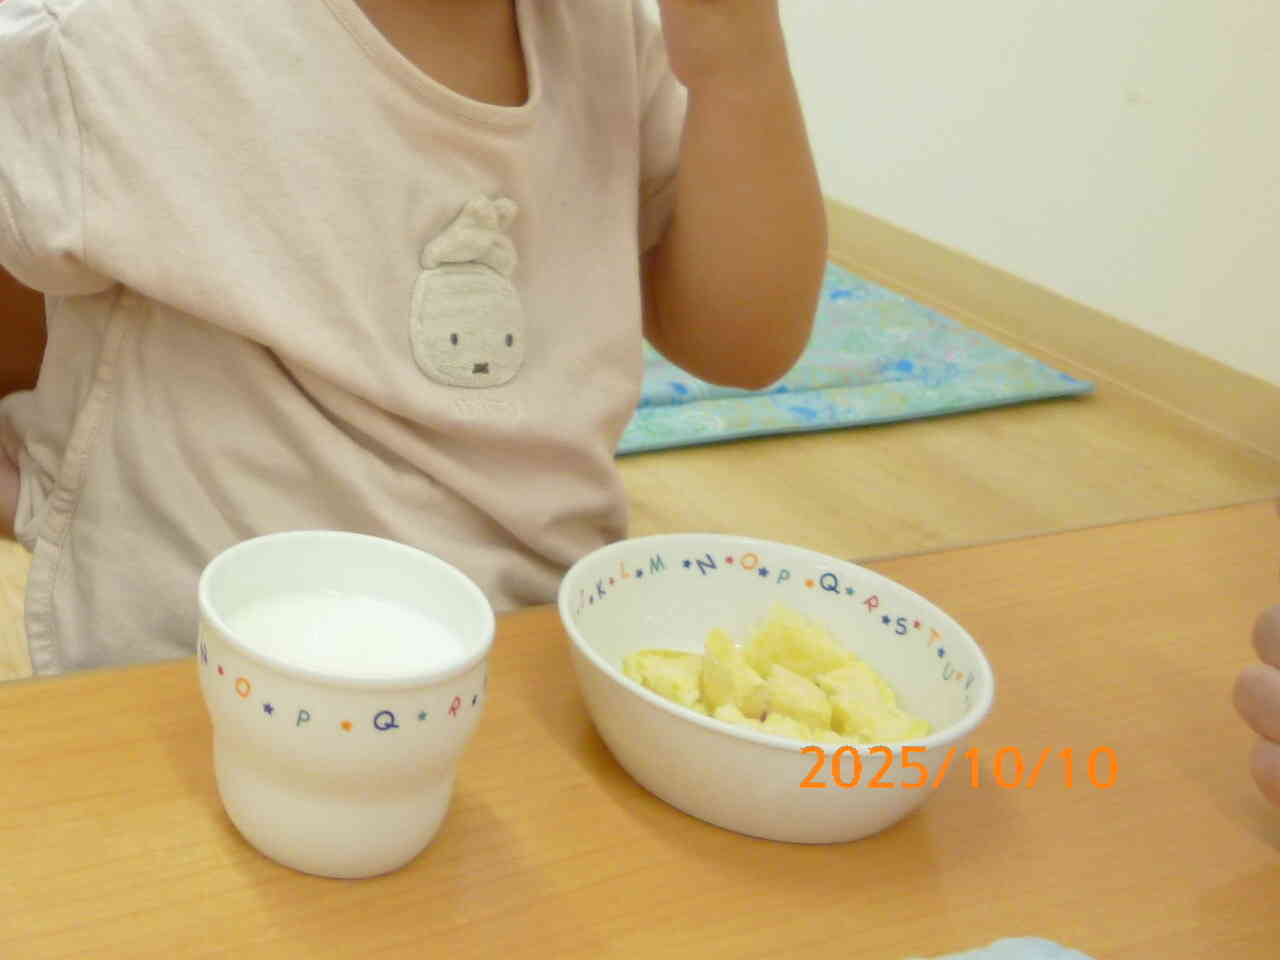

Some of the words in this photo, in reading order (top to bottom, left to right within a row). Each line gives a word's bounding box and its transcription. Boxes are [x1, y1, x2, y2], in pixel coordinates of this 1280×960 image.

[596, 580, 606, 599] K
[618, 559, 631, 579] L
[649, 552, 664, 574] M
[696, 552, 717, 575] N
[741, 552, 758, 570] O
[777, 568, 790, 584] P
[820, 572, 840, 593] Q
[863, 595, 878, 613] R
[896, 616, 907, 635] S
[928, 626, 942, 647] T
[235, 676, 250, 699] O
[296, 708, 310, 727] P
[374, 709, 400, 731] Q
[448, 695, 461, 717] R
